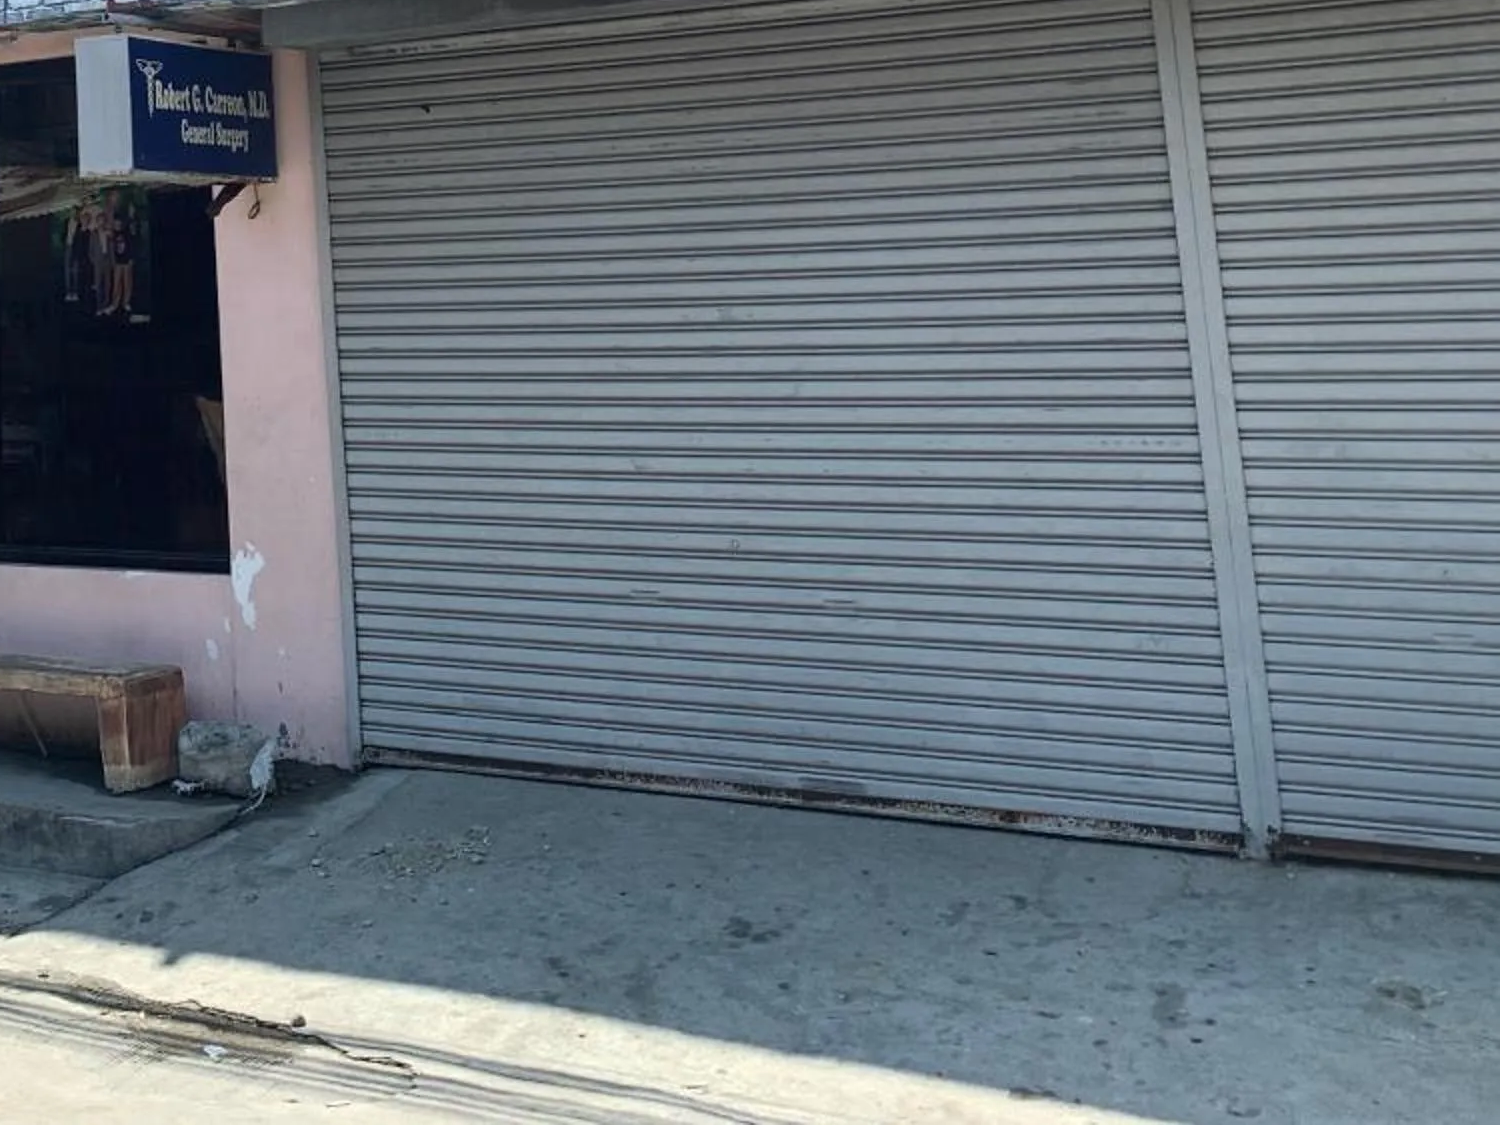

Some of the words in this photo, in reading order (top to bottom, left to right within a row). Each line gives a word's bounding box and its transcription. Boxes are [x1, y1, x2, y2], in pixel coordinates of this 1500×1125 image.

[156, 80, 190, 111] Robert
[192, 84, 205, 113] G.
[248, 90, 270, 119] M.D.
[182, 119, 214, 145] General
[216, 121, 249, 153] Surgery
